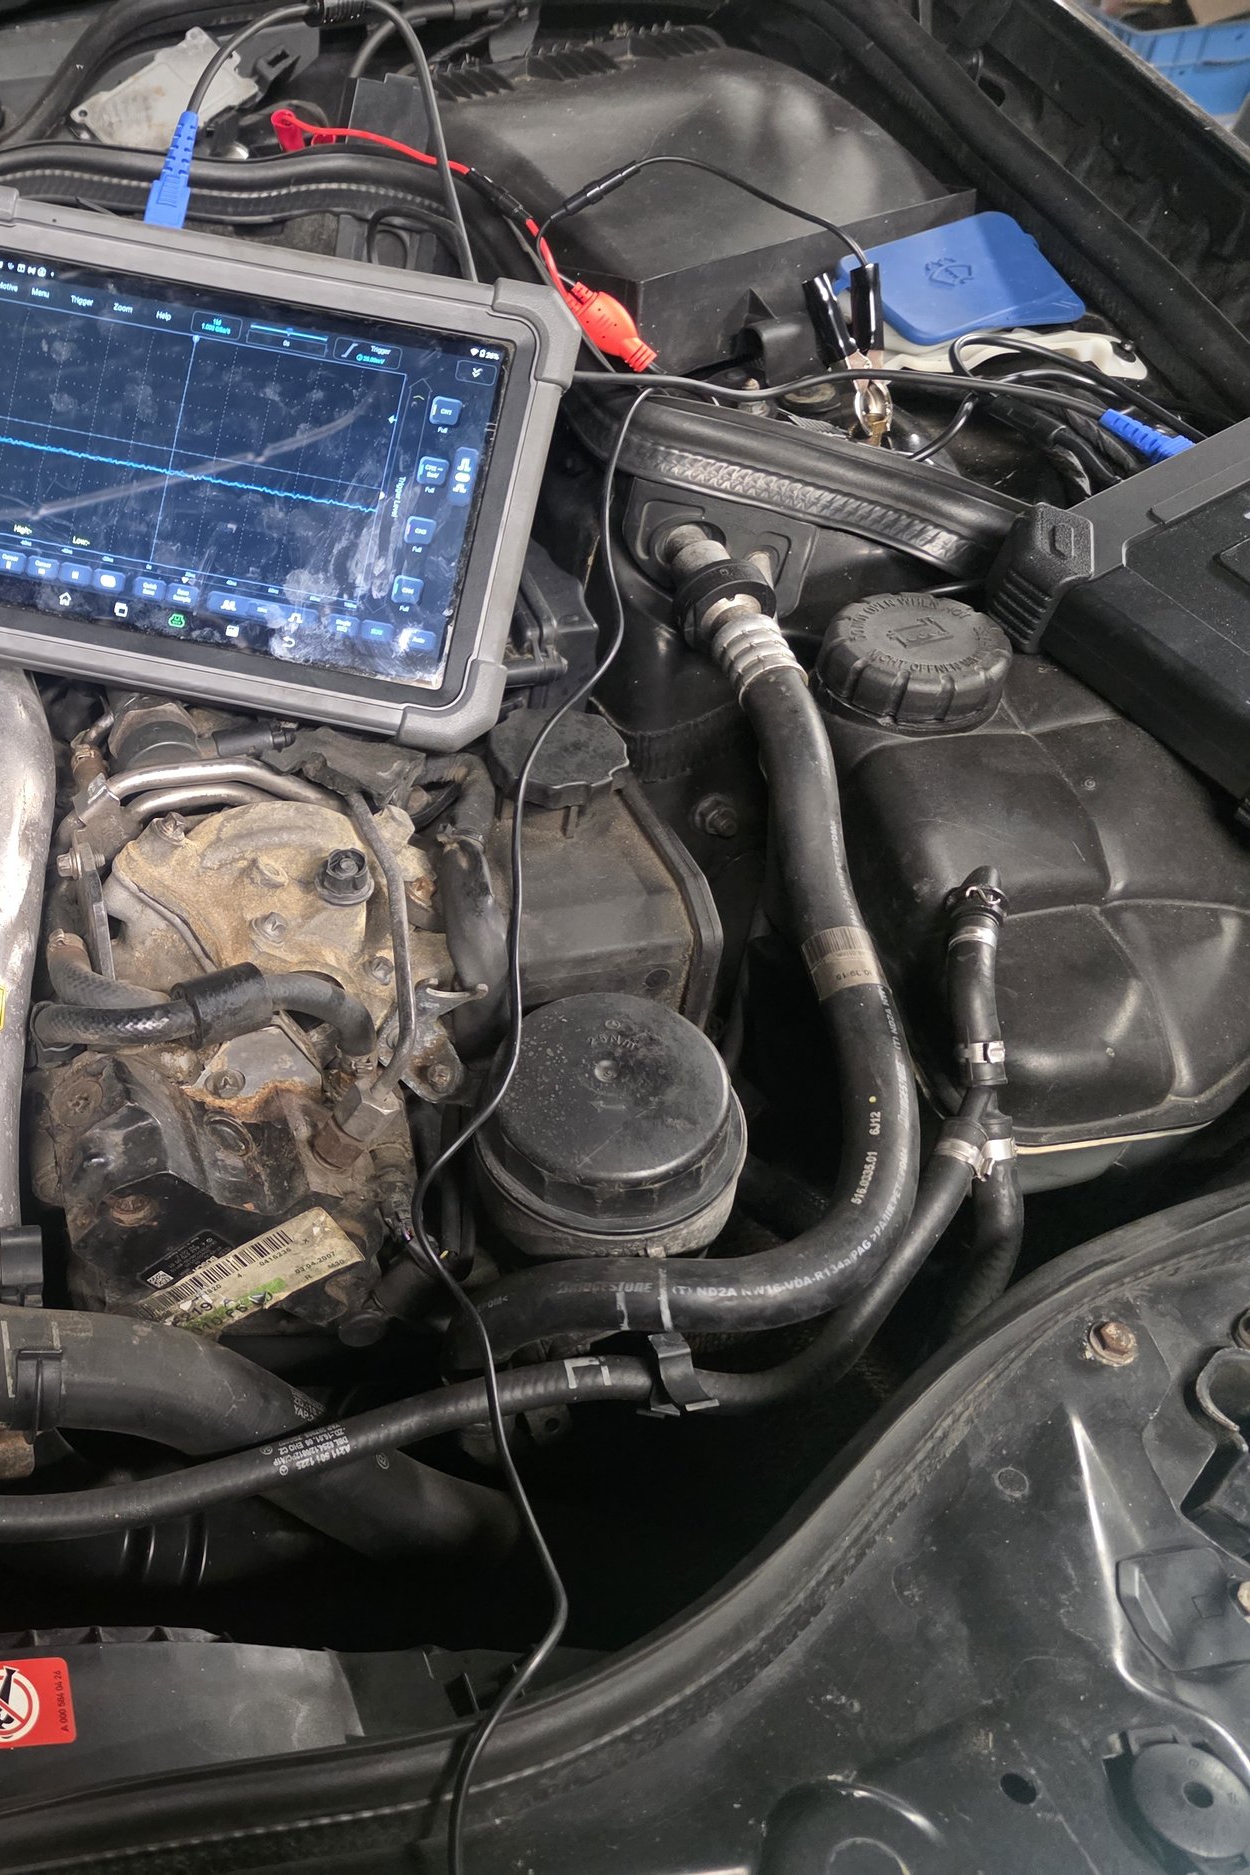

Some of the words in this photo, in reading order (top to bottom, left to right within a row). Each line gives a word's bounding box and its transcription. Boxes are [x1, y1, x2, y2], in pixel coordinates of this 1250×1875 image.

[31, 287, 50, 298] Menu
[70, 294, 94, 307] Trigger
[113, 303, 133, 314] Zoom
[155, 310, 172, 322] Help
[370, 345, 392, 356] Trigger
[850, 1151, 878, 1206] 516.0335.01
[869, 1111, 882, 1136] 6J12
[294, 1251, 337, 1275] 03.04.2007
[53, 1670, 62, 1680] 26
[54, 1681, 64, 1691] 04
[58, 1708, 68, 1724] 000
